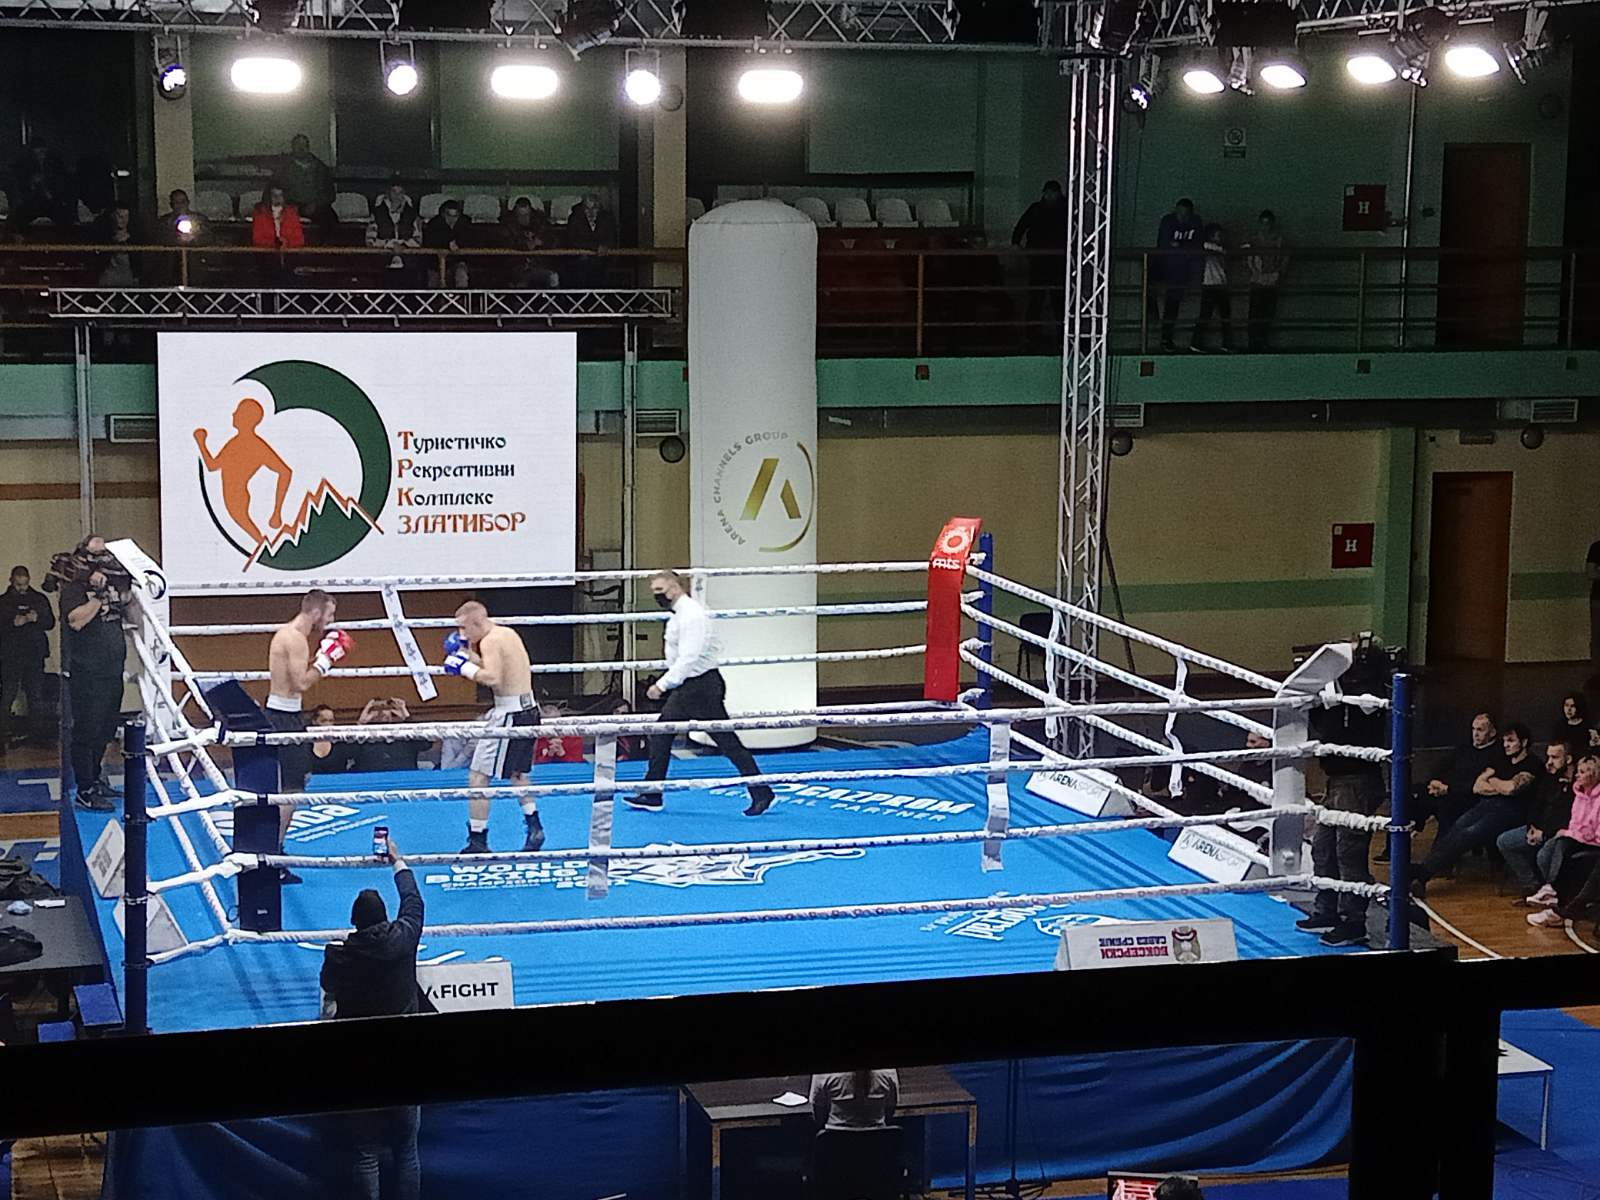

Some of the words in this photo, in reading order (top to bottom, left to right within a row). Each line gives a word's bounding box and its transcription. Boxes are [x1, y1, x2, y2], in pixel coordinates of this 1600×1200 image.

[397, 431, 506, 454] Туристичко
[397, 458, 515, 481] Рекреативни
[713, 441, 742, 504] CHANNELS
[745, 431, 789, 445] GROUP
[397, 487, 494, 506] Комплекс
[397, 512, 526, 534] ЗЛАТИБОР
[795, 785, 975, 814] GAZPROM
[830, 802, 947, 822] PARTNER
[425, 869, 578, 884] BOXING
[450, 860, 589, 874] WORLD
